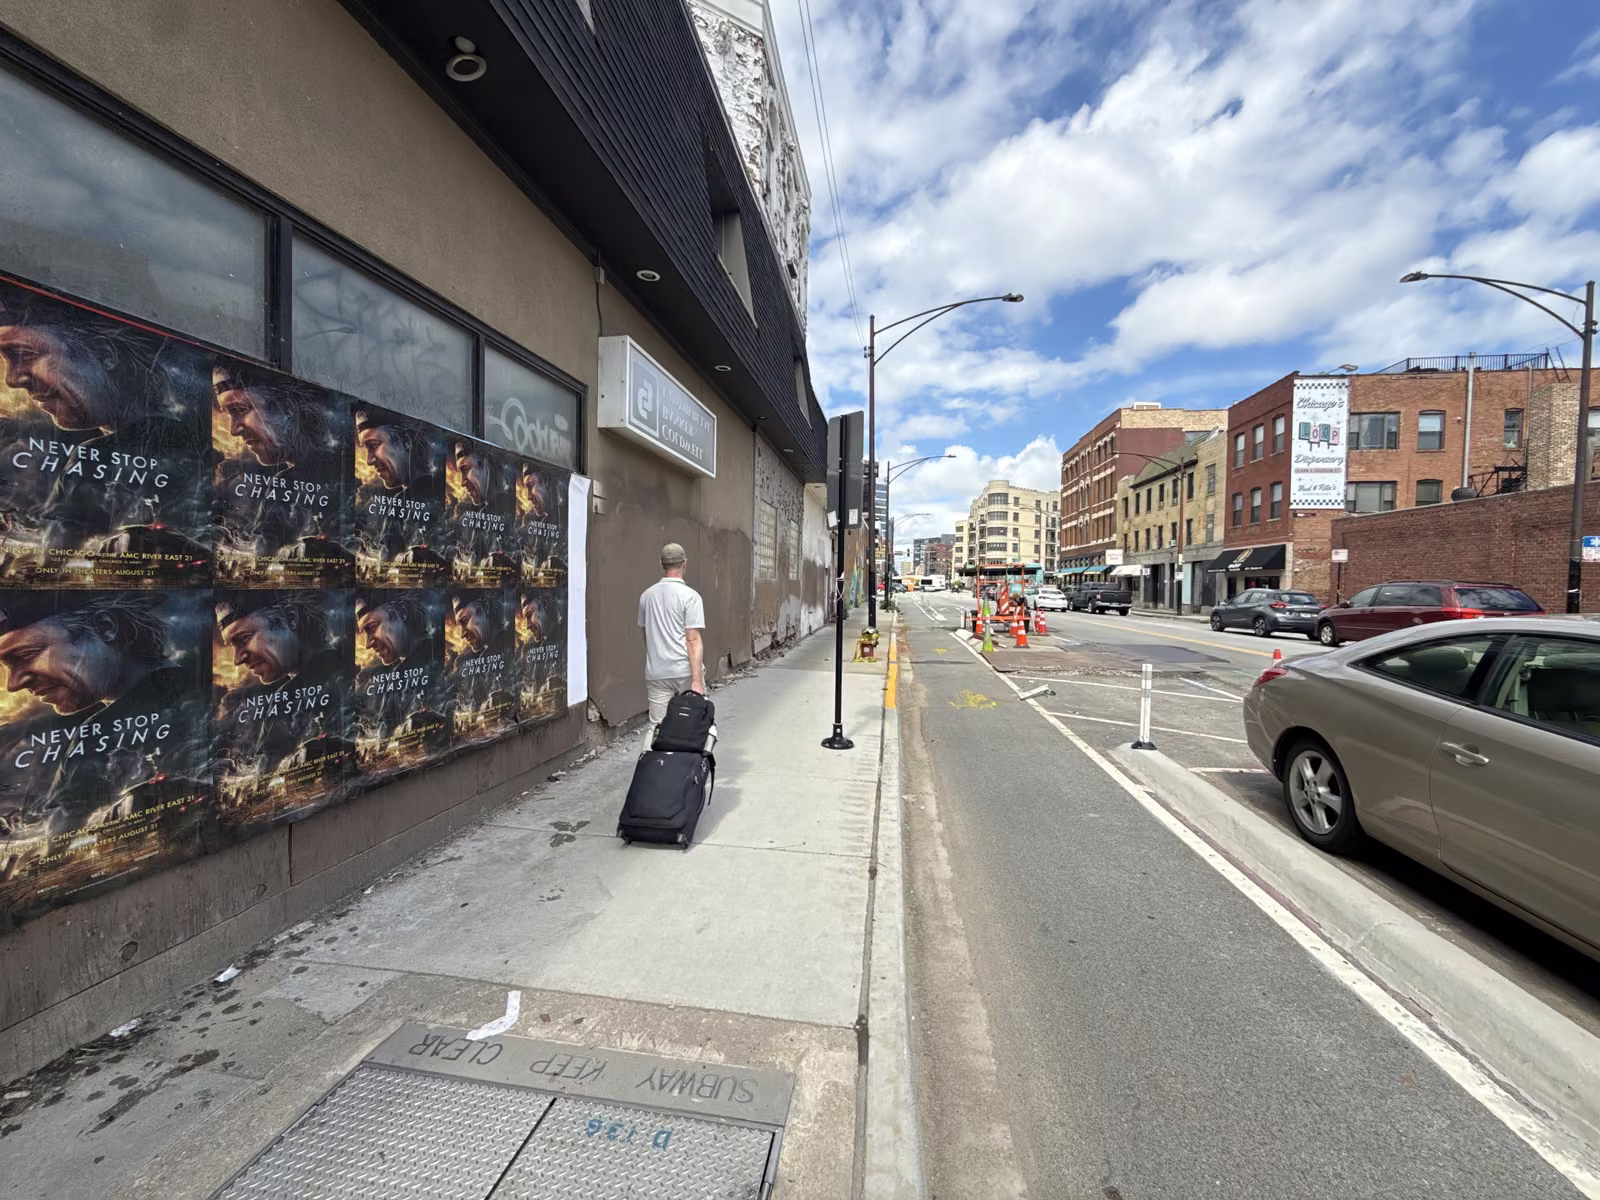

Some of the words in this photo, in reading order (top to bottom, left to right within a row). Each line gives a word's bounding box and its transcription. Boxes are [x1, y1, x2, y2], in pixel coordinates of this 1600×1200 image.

[1297, 397, 1345, 412] Chicago's
[1301, 424, 1339, 443] LOOP
[29, 436, 100, 462] NEVER
[111, 451, 158, 470] STOP
[1294, 454, 1344, 466] Dispensary
[12, 452, 169, 488] CHASING
[243, 472, 287, 489] NEVER
[293, 480, 321, 493] STOP
[235, 483, 329, 507] CHASING
[374, 494, 402, 507] NEVER
[405, 500, 426, 510] STOP
[368, 503, 431, 521] CHASING
[465, 510, 485, 520] NEVER
[486, 514, 501, 522] STOP
[461, 518, 505, 532] CHASING
[527, 526, 560, 538] CHASING
[48, 548, 96, 557] CHICAGO
[465, 657, 485, 667] NEVER
[486, 654, 501, 663] STOP
[526, 650, 559, 663] CHASING
[372, 671, 400, 684] NEVER
[403, 667, 424, 679] STOP
[461, 661, 505, 677] CHASING
[366, 675, 429, 696] CHASING
[246, 691, 289, 708] NEVER
[295, 685, 322, 699] STOP
[238, 693, 330, 724] CHASING
[31, 723, 102, 748] NEVER
[113, 713, 160, 732] STOP
[14, 724, 171, 769] CHASING
[52, 824, 98, 843] CHICAGO
[123, 810, 144, 821] AMC
[145, 804, 165, 815] RIVER
[167, 797, 185, 808] EAST
[186, 794, 195, 802] 21
[38, 853, 63, 865] ONLY
[65, 849, 75, 857] IN
[79, 836, 117, 852] THEATERS
[119, 826, 148, 840] AUGUST
[408, 1033, 503, 1065] CLEAR
[529, 1053, 609, 1081] KEEP
[635, 1065, 759, 1103] SUBWAY
